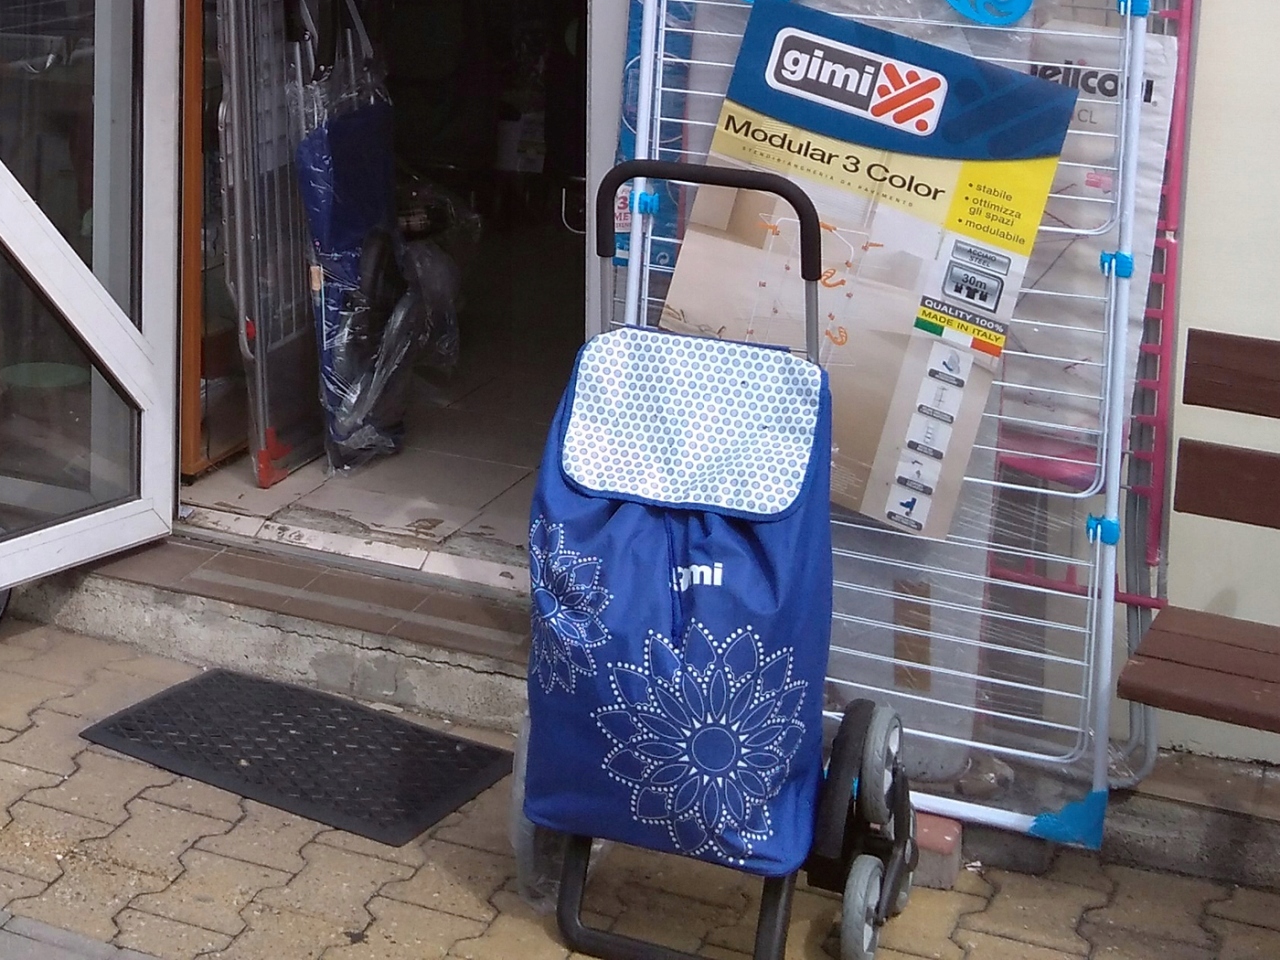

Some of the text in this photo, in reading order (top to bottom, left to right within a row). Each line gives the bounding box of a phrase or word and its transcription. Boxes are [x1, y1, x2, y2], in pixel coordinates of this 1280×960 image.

[781, 49, 875, 96] gimi
[724, 114, 945, 201] Modular 3 Color
[976, 183, 1013, 202] stabile
[969, 206, 1016, 227] gli spazi
[972, 196, 1022, 219] ottimizza
[965, 219, 1026, 245] modulabile
[962, 274, 987, 290] 30m
[921, 309, 1002, 343] MADE IN ITALY
[924, 299, 1005, 333] QUALITY 100%
